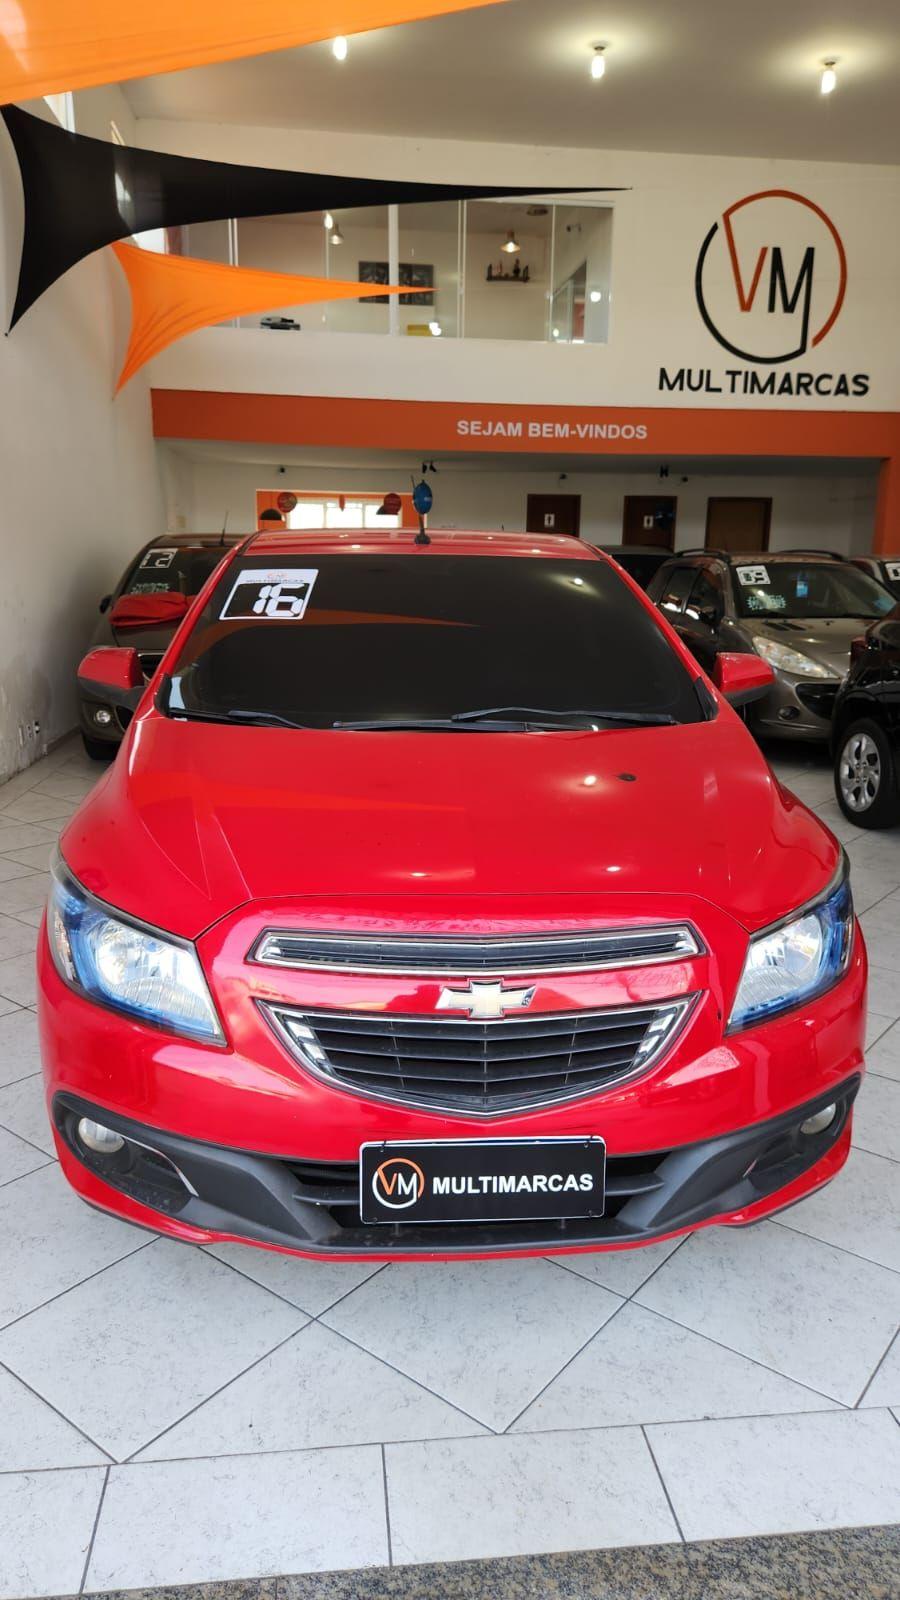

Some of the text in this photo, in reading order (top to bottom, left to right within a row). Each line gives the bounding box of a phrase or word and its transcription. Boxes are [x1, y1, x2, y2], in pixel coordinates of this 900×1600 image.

[658, 367, 870, 396] MULTIMARCAS
[456, 420, 648, 439] SEJAM BEM-VINDOS
[252, 583, 305, 617] 16
[432, 1174, 594, 1195] MULTIMARCAS
